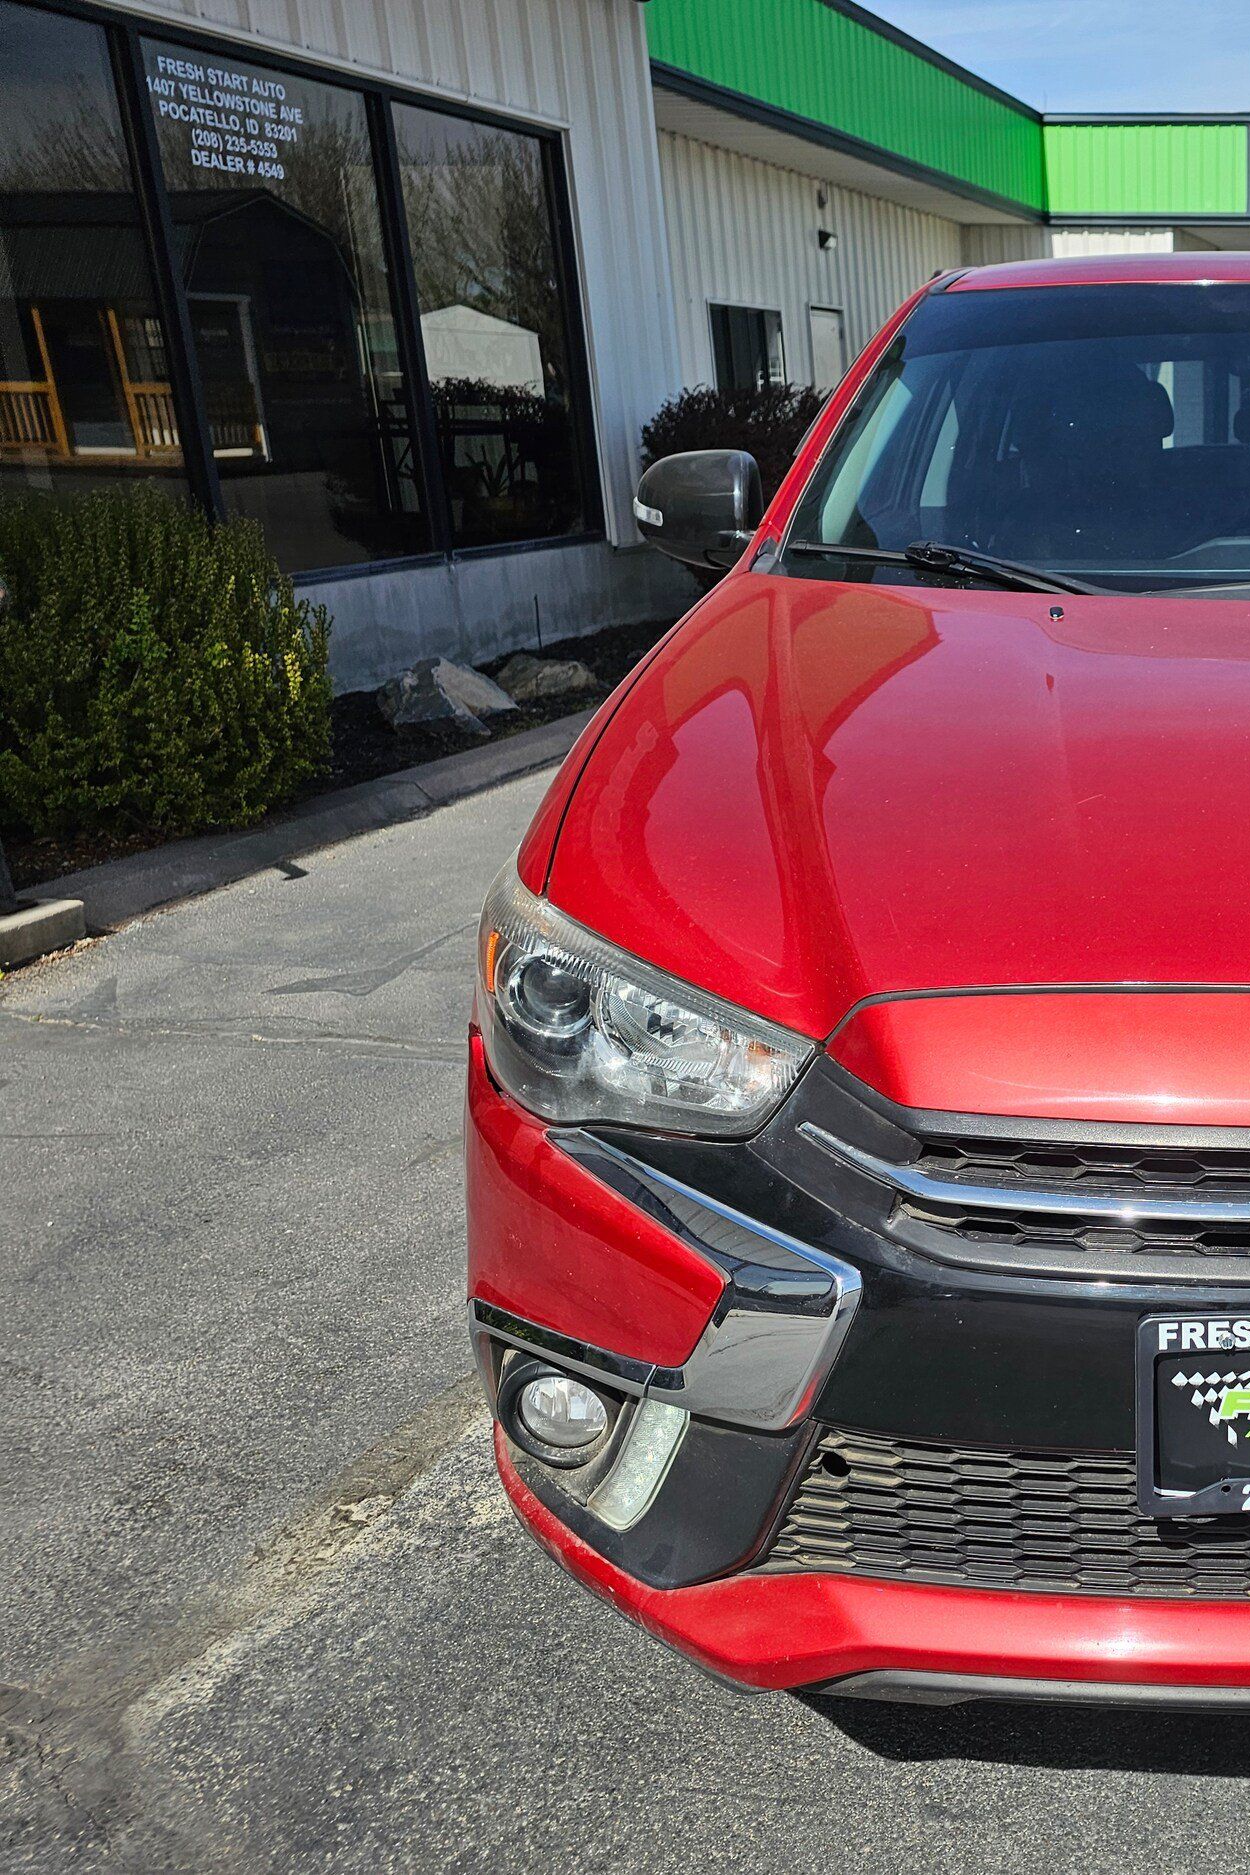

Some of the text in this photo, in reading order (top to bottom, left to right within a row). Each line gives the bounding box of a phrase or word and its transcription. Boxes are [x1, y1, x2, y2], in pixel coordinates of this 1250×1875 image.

[157, 55, 286, 101] FRESH START AUTO
[146, 75, 303, 125] 1407 YELLOWSTONE AVE
[159, 100, 297, 143] POCATELLO, ID 83201
[191, 149, 285, 180] DEALER # 4549
[192, 129, 278, 158] (208) 235-5353
